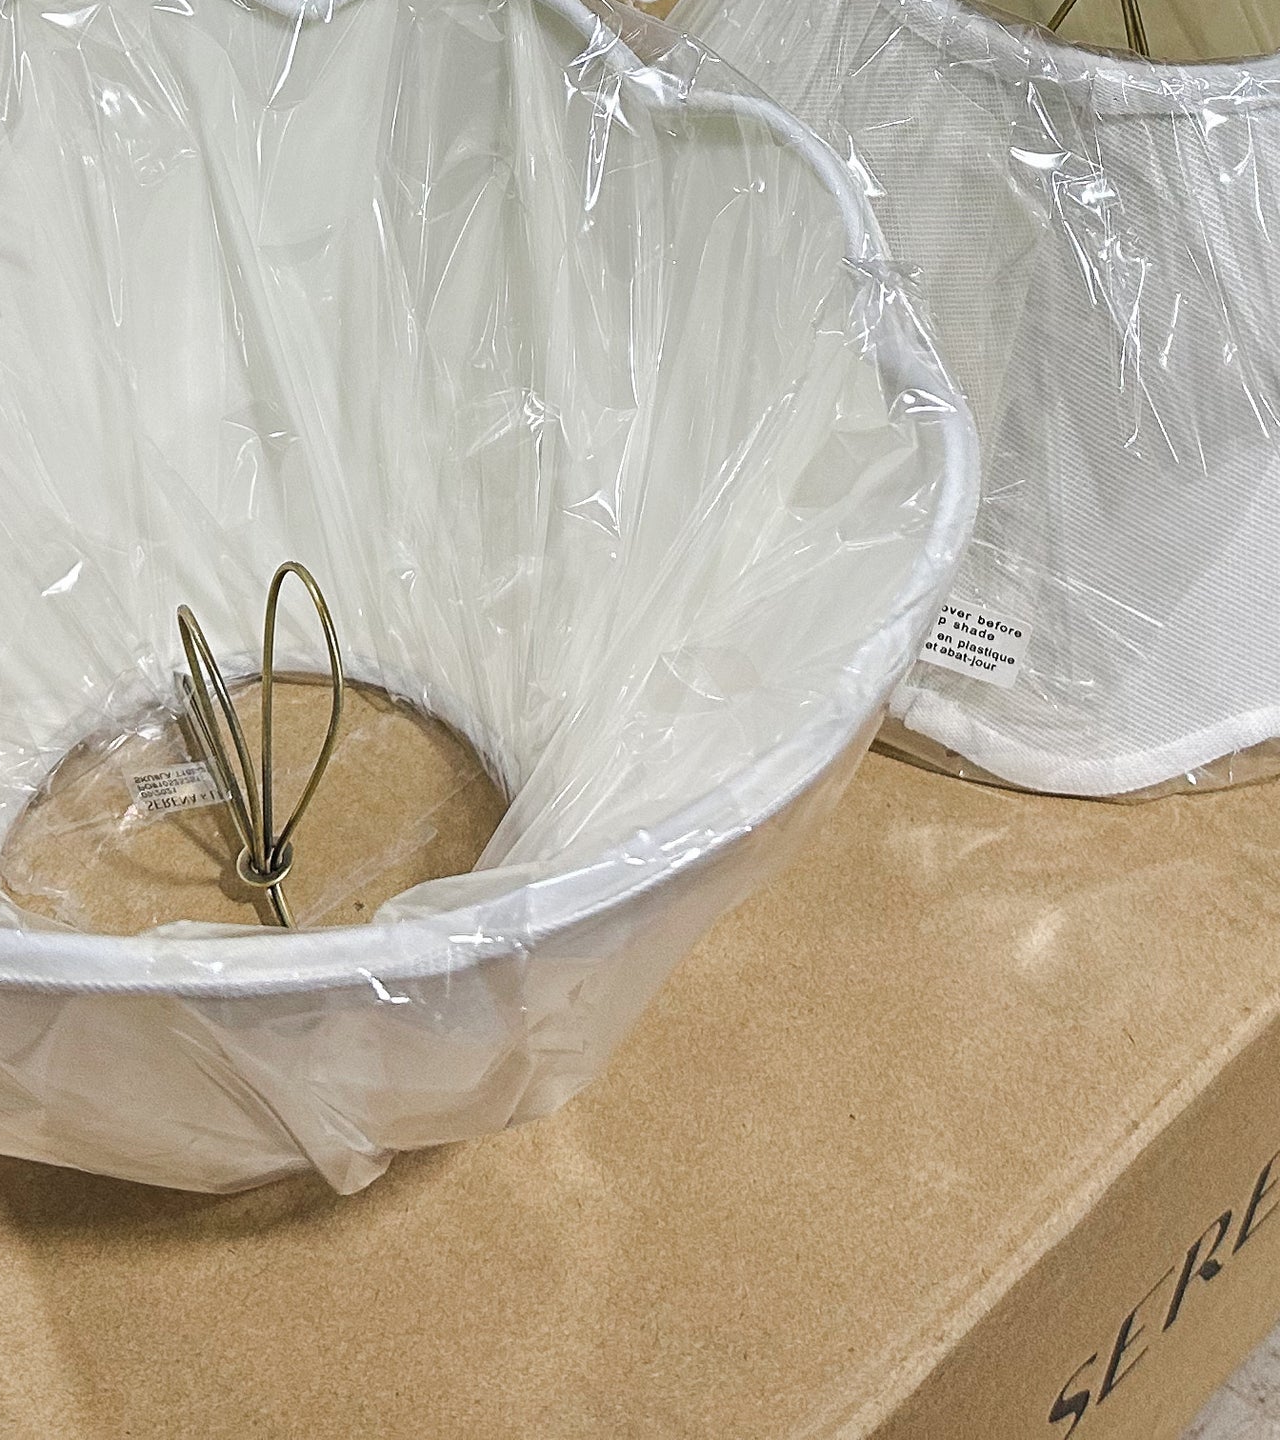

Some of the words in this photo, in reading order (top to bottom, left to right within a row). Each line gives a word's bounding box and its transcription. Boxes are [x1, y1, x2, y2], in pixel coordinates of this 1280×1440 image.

[953, 621, 995, 641] shade
[977, 615, 1022, 638] before
[925, 641, 938, 652] et
[939, 644, 997, 671] abat-jour
[937, 632, 952, 644] en
[957, 640, 1015, 665] plastique
